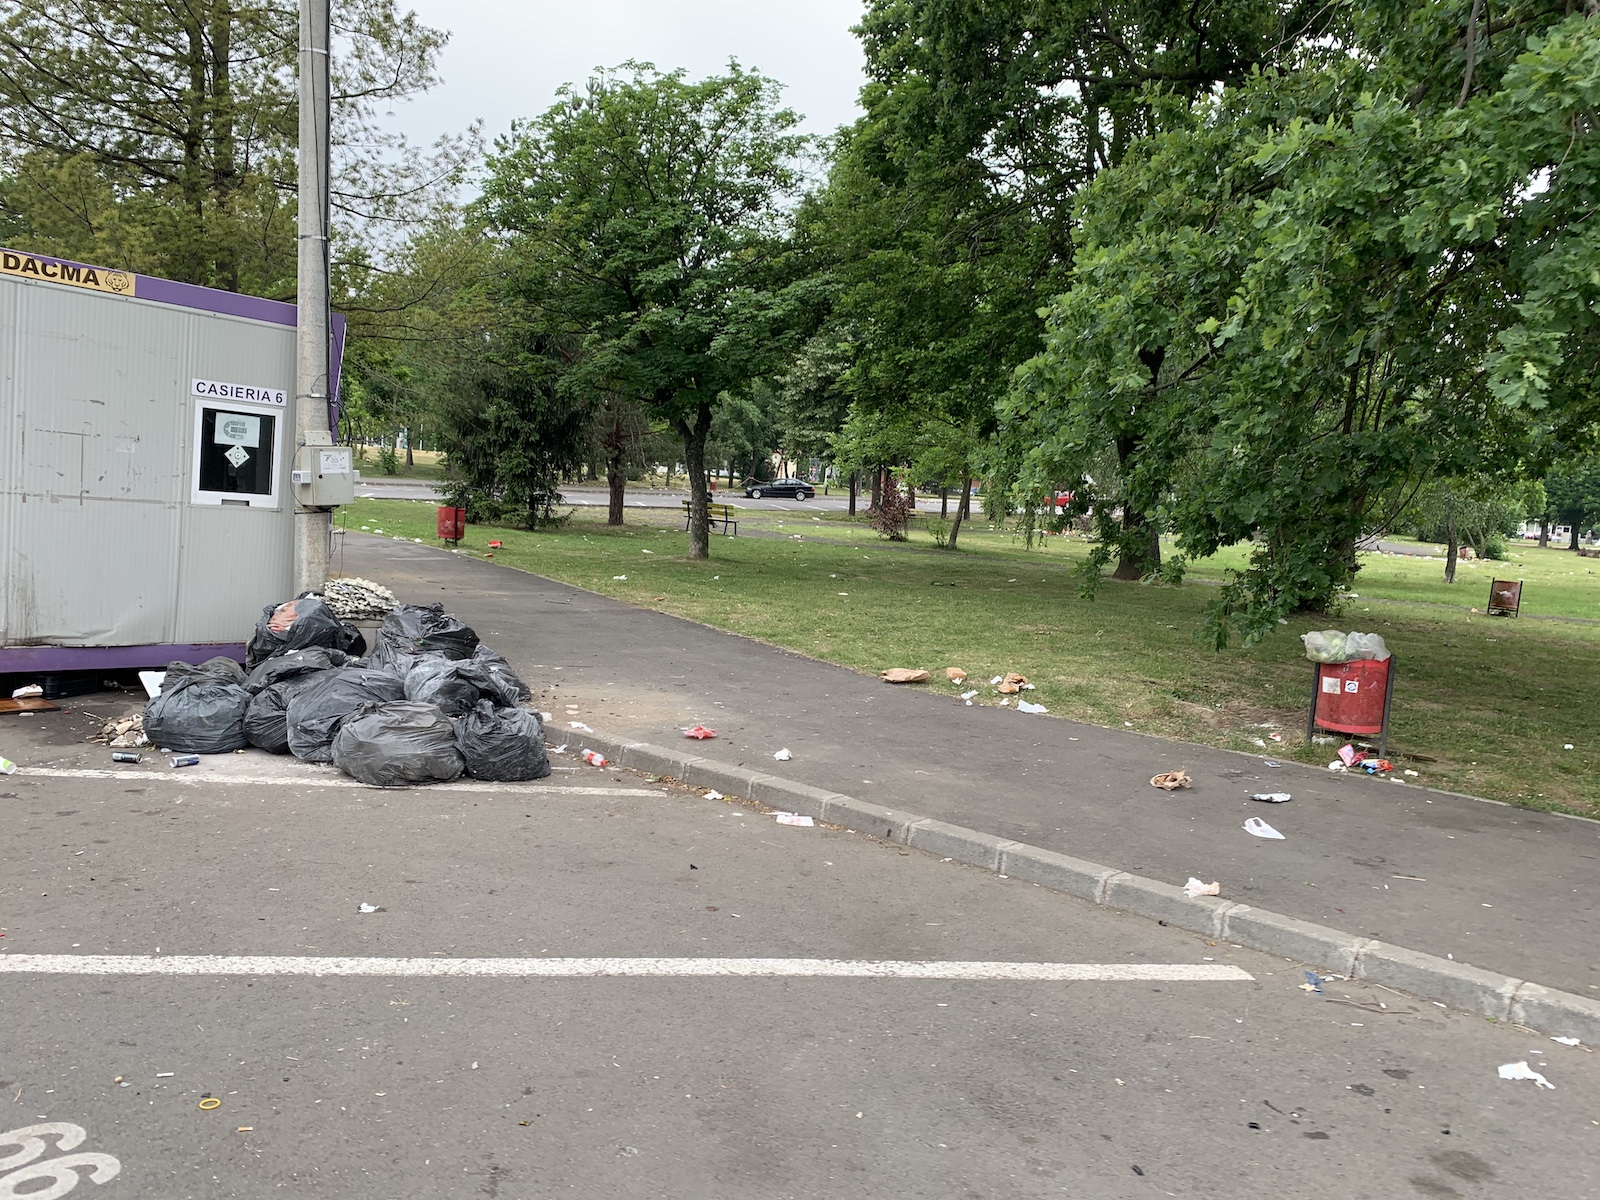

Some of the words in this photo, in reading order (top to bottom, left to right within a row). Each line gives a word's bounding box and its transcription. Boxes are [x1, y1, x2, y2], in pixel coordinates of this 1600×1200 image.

[3, 253, 100, 286] DACMA
[196, 382, 271, 402] CASIERIA
[275, 392, 283, 404] 6
